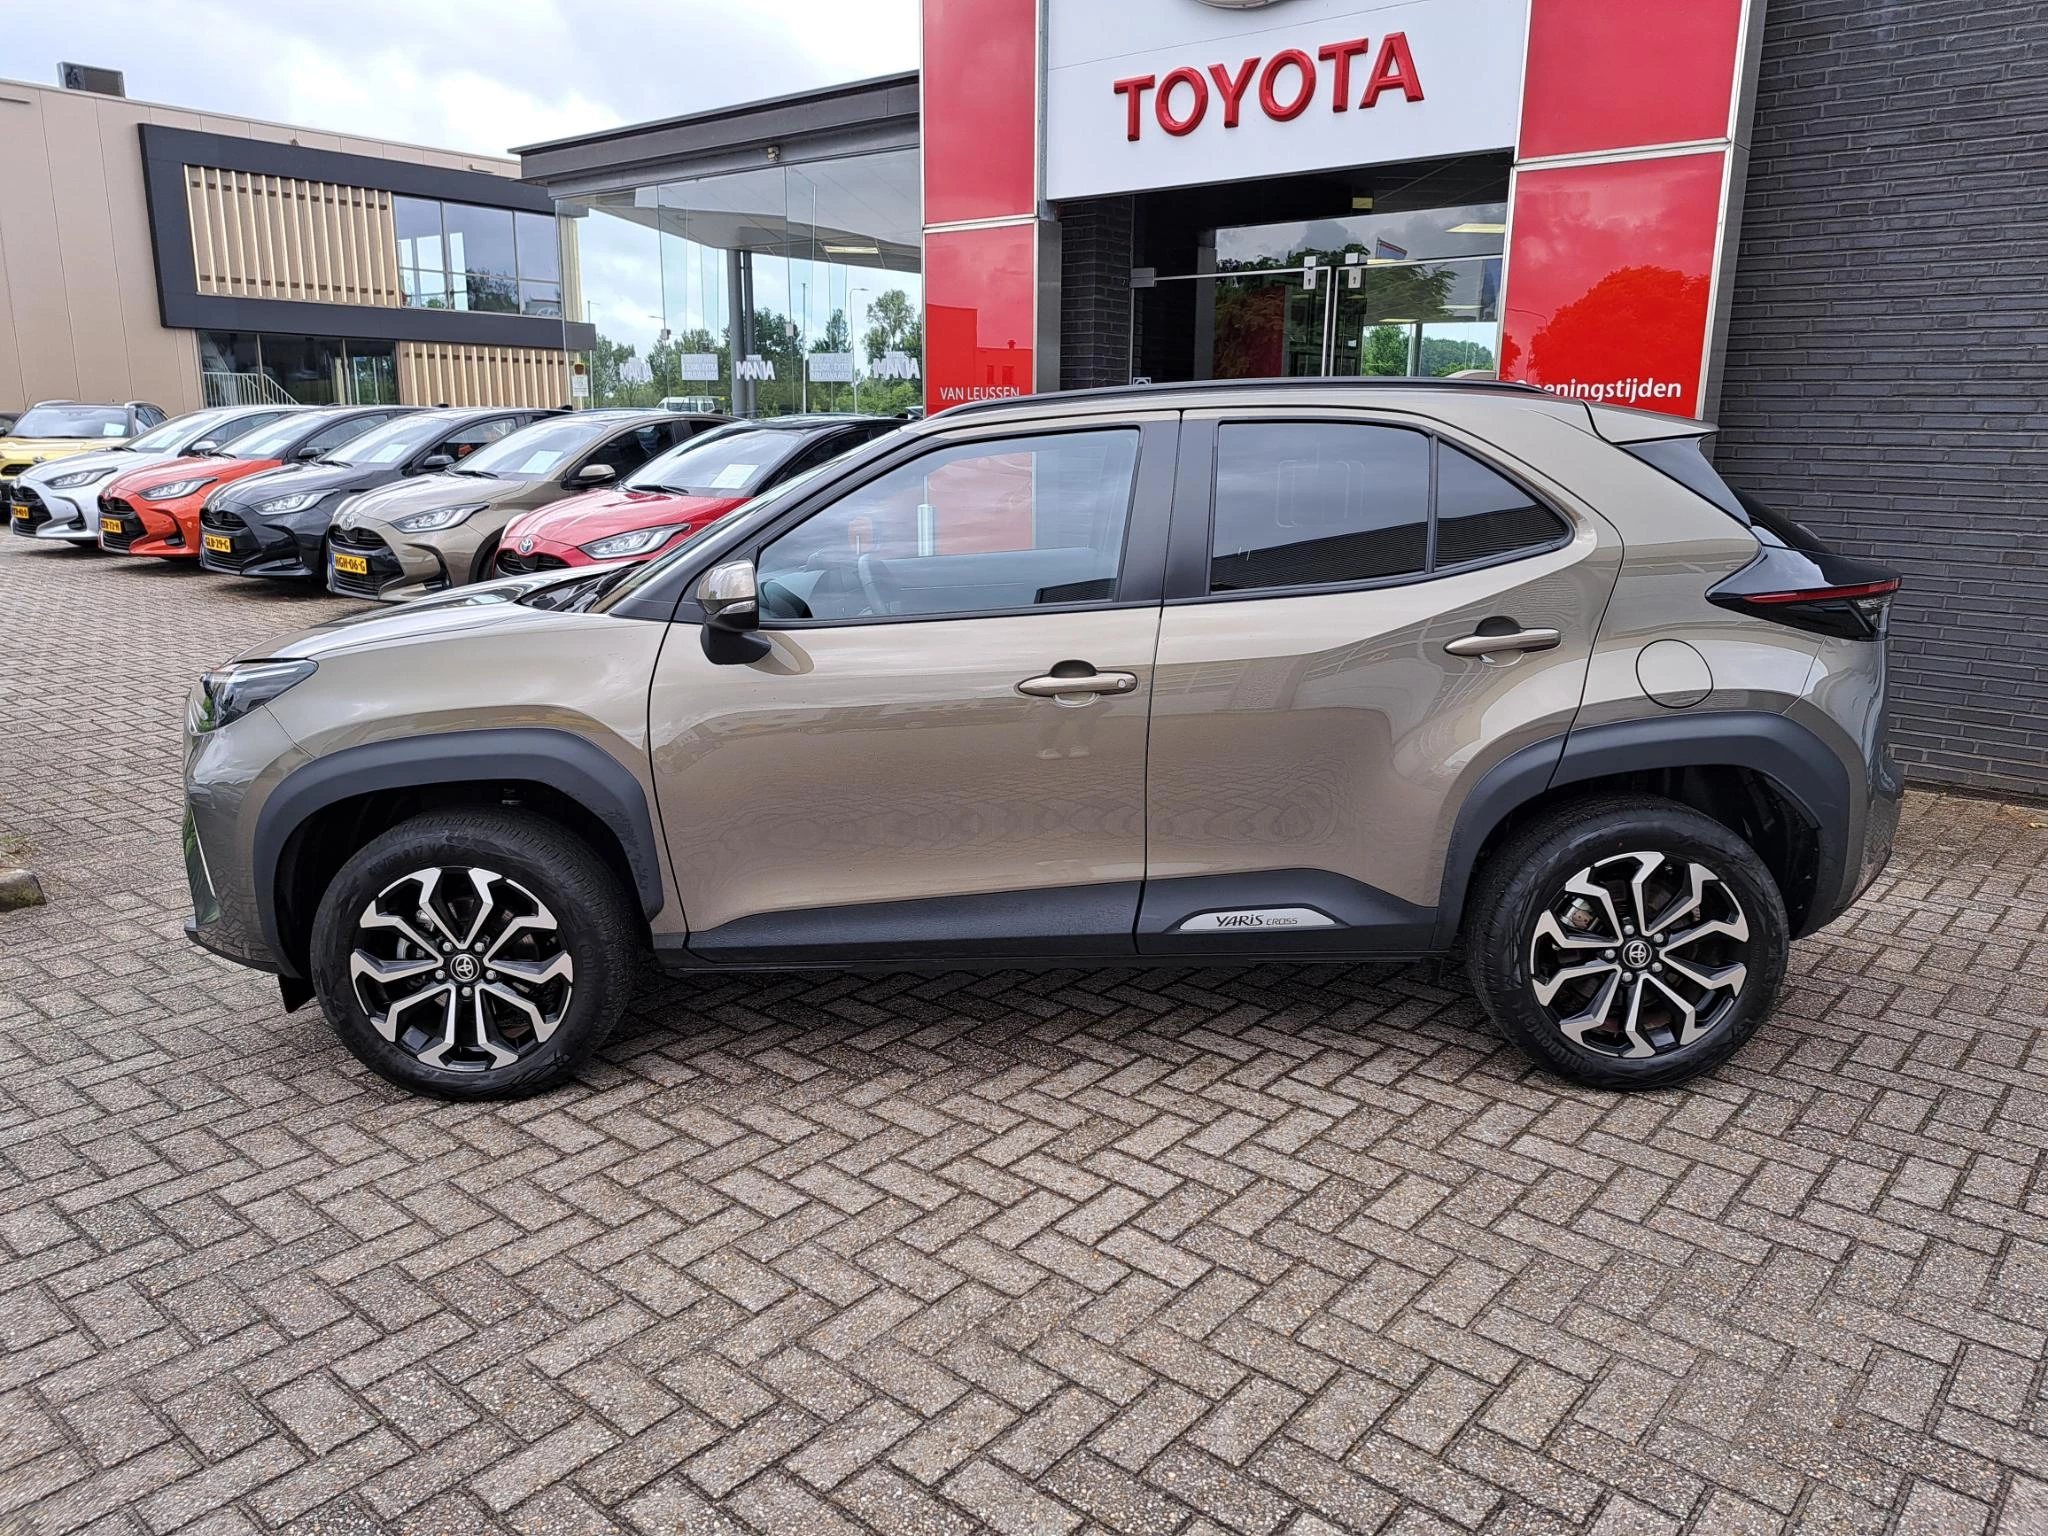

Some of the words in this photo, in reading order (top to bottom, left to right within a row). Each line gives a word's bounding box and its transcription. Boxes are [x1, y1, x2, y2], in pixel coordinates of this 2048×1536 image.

[1113, 32, 1425, 142] TOYOTA
[940, 386, 964, 400] VAN
[967, 386, 1020, 400] LEUSSEN
[1515, 377, 1681, 403] eningstijden
[1266, 917, 1298, 926] CROSS
